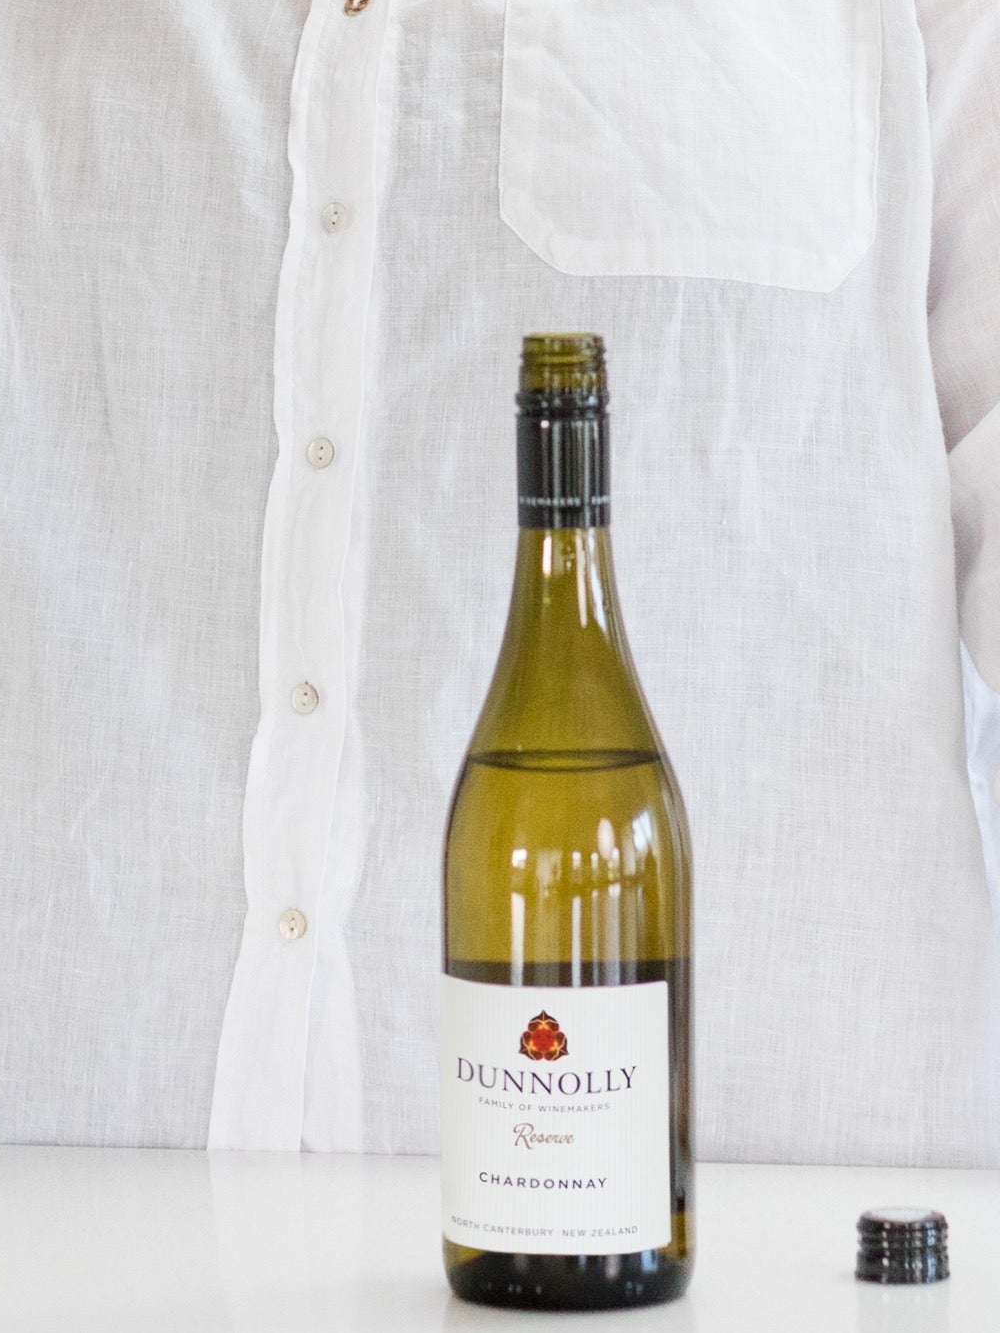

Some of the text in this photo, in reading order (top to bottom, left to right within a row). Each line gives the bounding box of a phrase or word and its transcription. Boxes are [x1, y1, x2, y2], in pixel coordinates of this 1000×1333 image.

[456, 1056, 638, 1096] DUNNOLLY
[478, 1096, 610, 1113] FAMILY OF WINEMAKERS
[513, 1122, 575, 1150] Reserve
[479, 1171, 608, 1189] CHARDONNAY
[451, 1215, 638, 1237] NORTH CANTERBURY NEW ZEALAND
